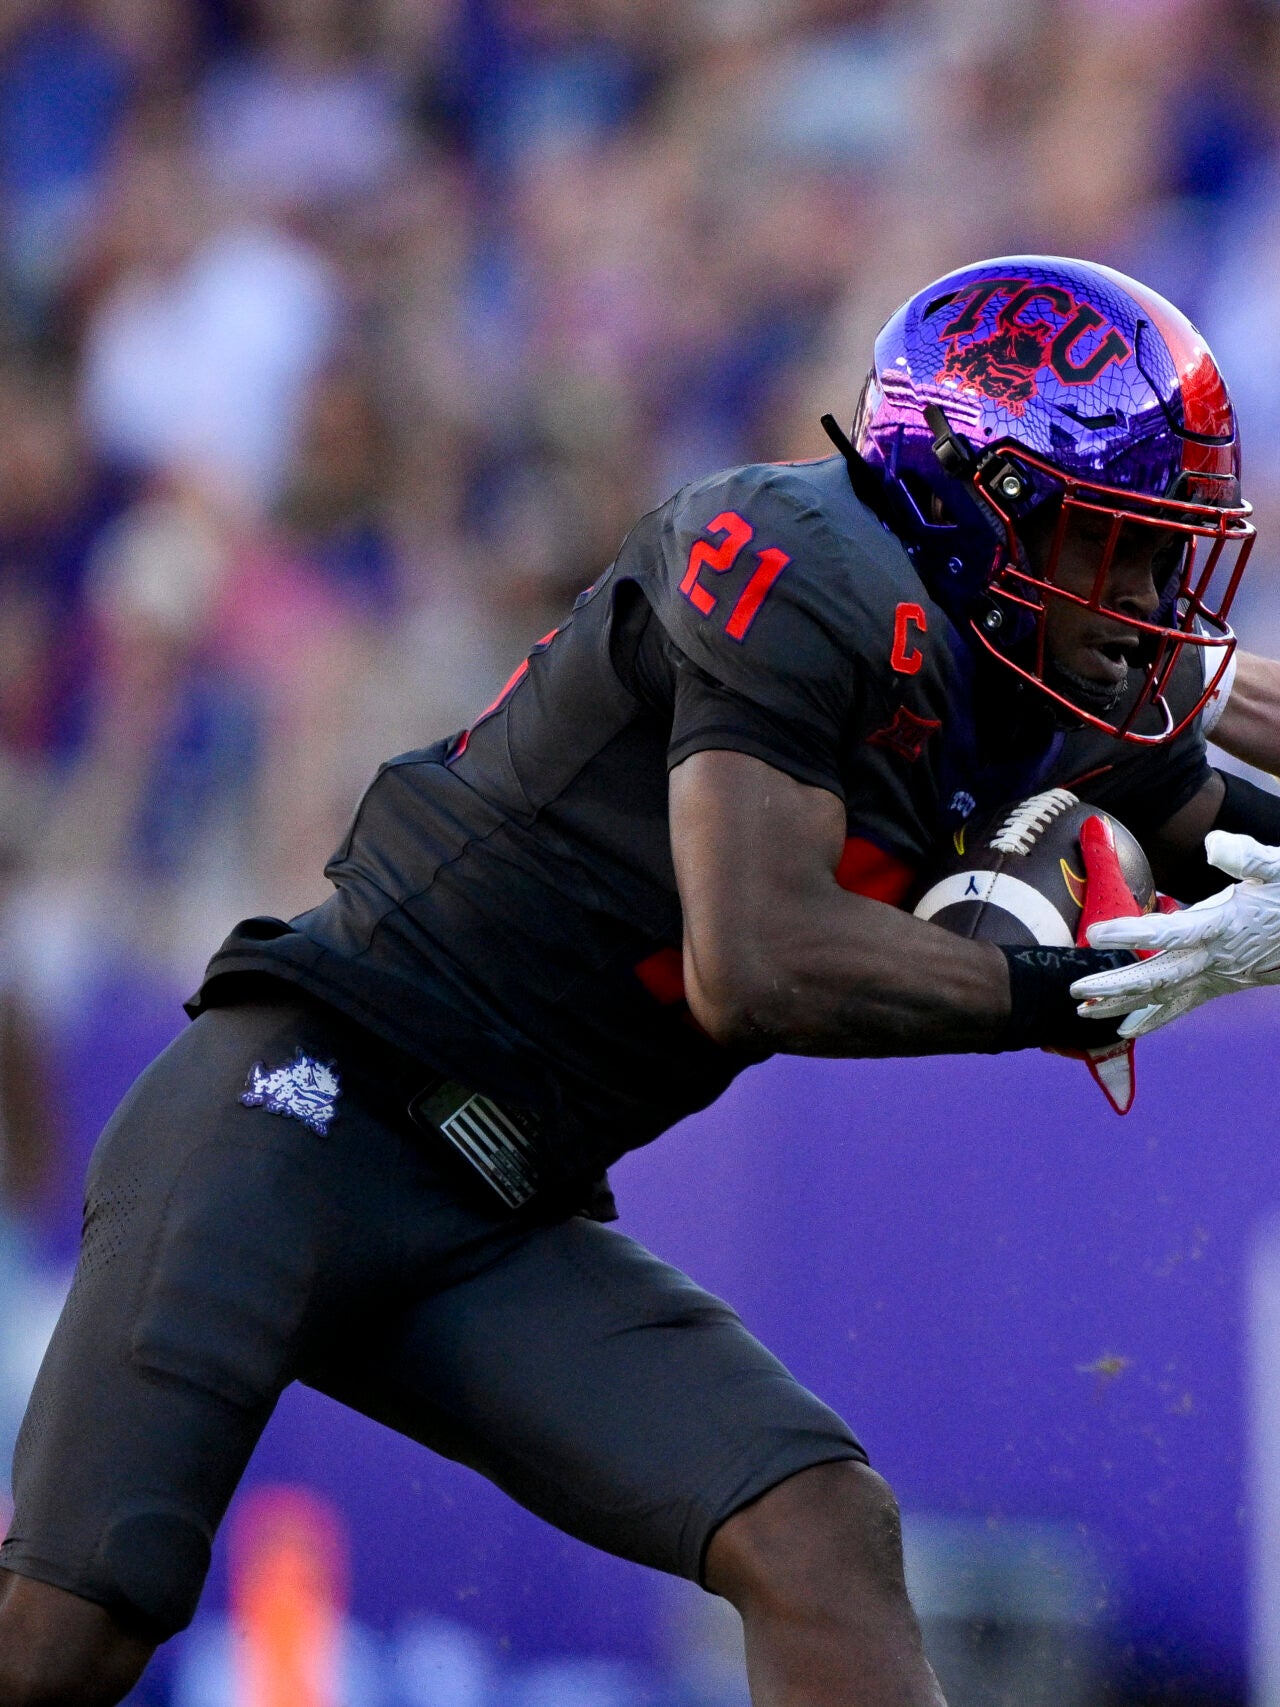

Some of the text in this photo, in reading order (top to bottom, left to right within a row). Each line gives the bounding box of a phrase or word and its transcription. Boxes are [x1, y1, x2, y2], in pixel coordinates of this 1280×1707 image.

[938, 277, 1133, 387] TCU
[677, 509, 794, 645] 21
[890, 602, 927, 675] C
